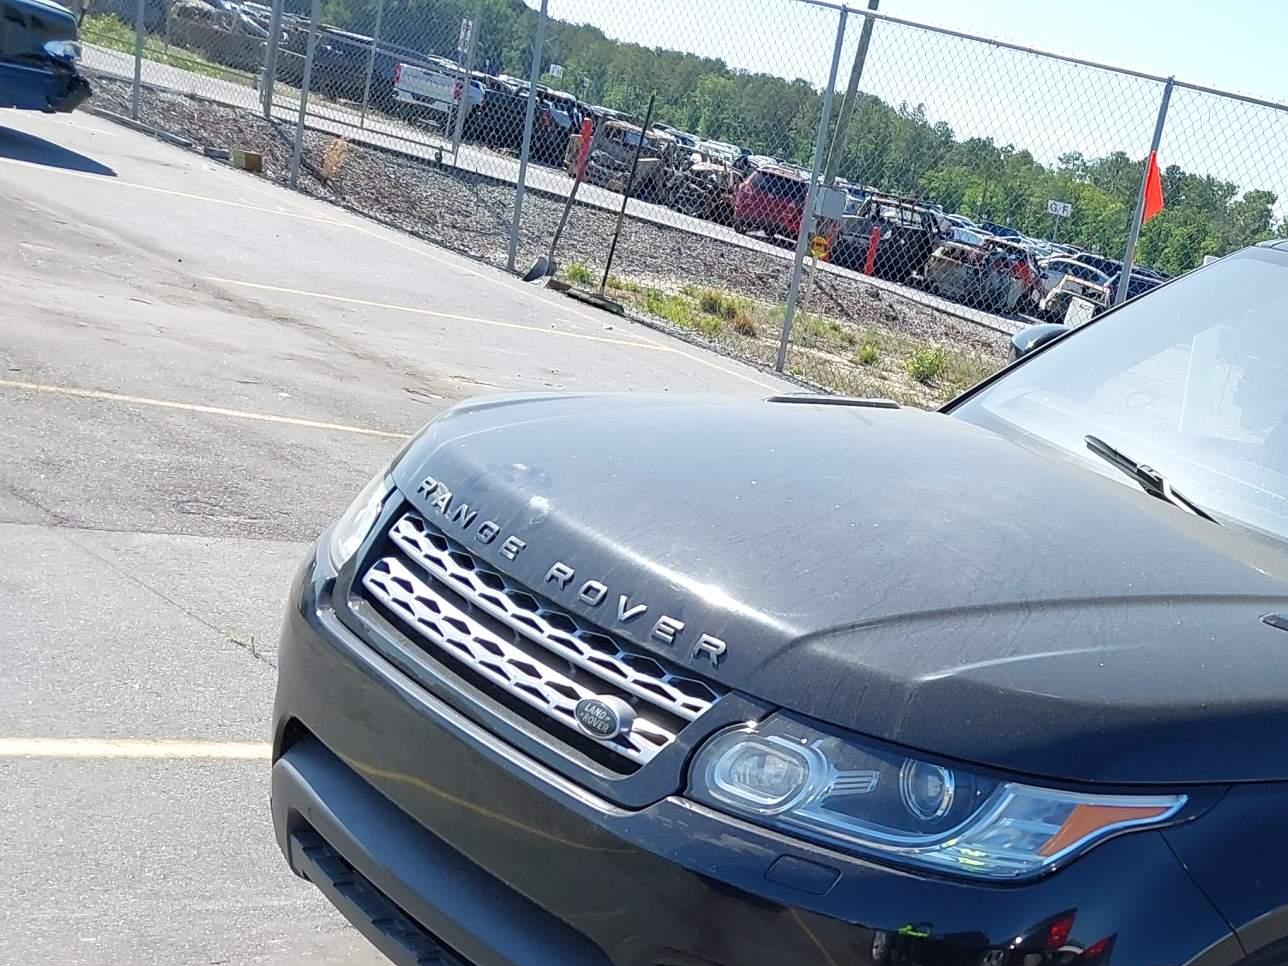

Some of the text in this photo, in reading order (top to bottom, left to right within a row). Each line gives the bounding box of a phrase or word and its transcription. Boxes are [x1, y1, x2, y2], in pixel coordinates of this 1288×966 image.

[415, 475, 728, 668] RANGE ROVER
[584, 703, 608, 719] LAND
[582, 714, 610, 734] ROVER
